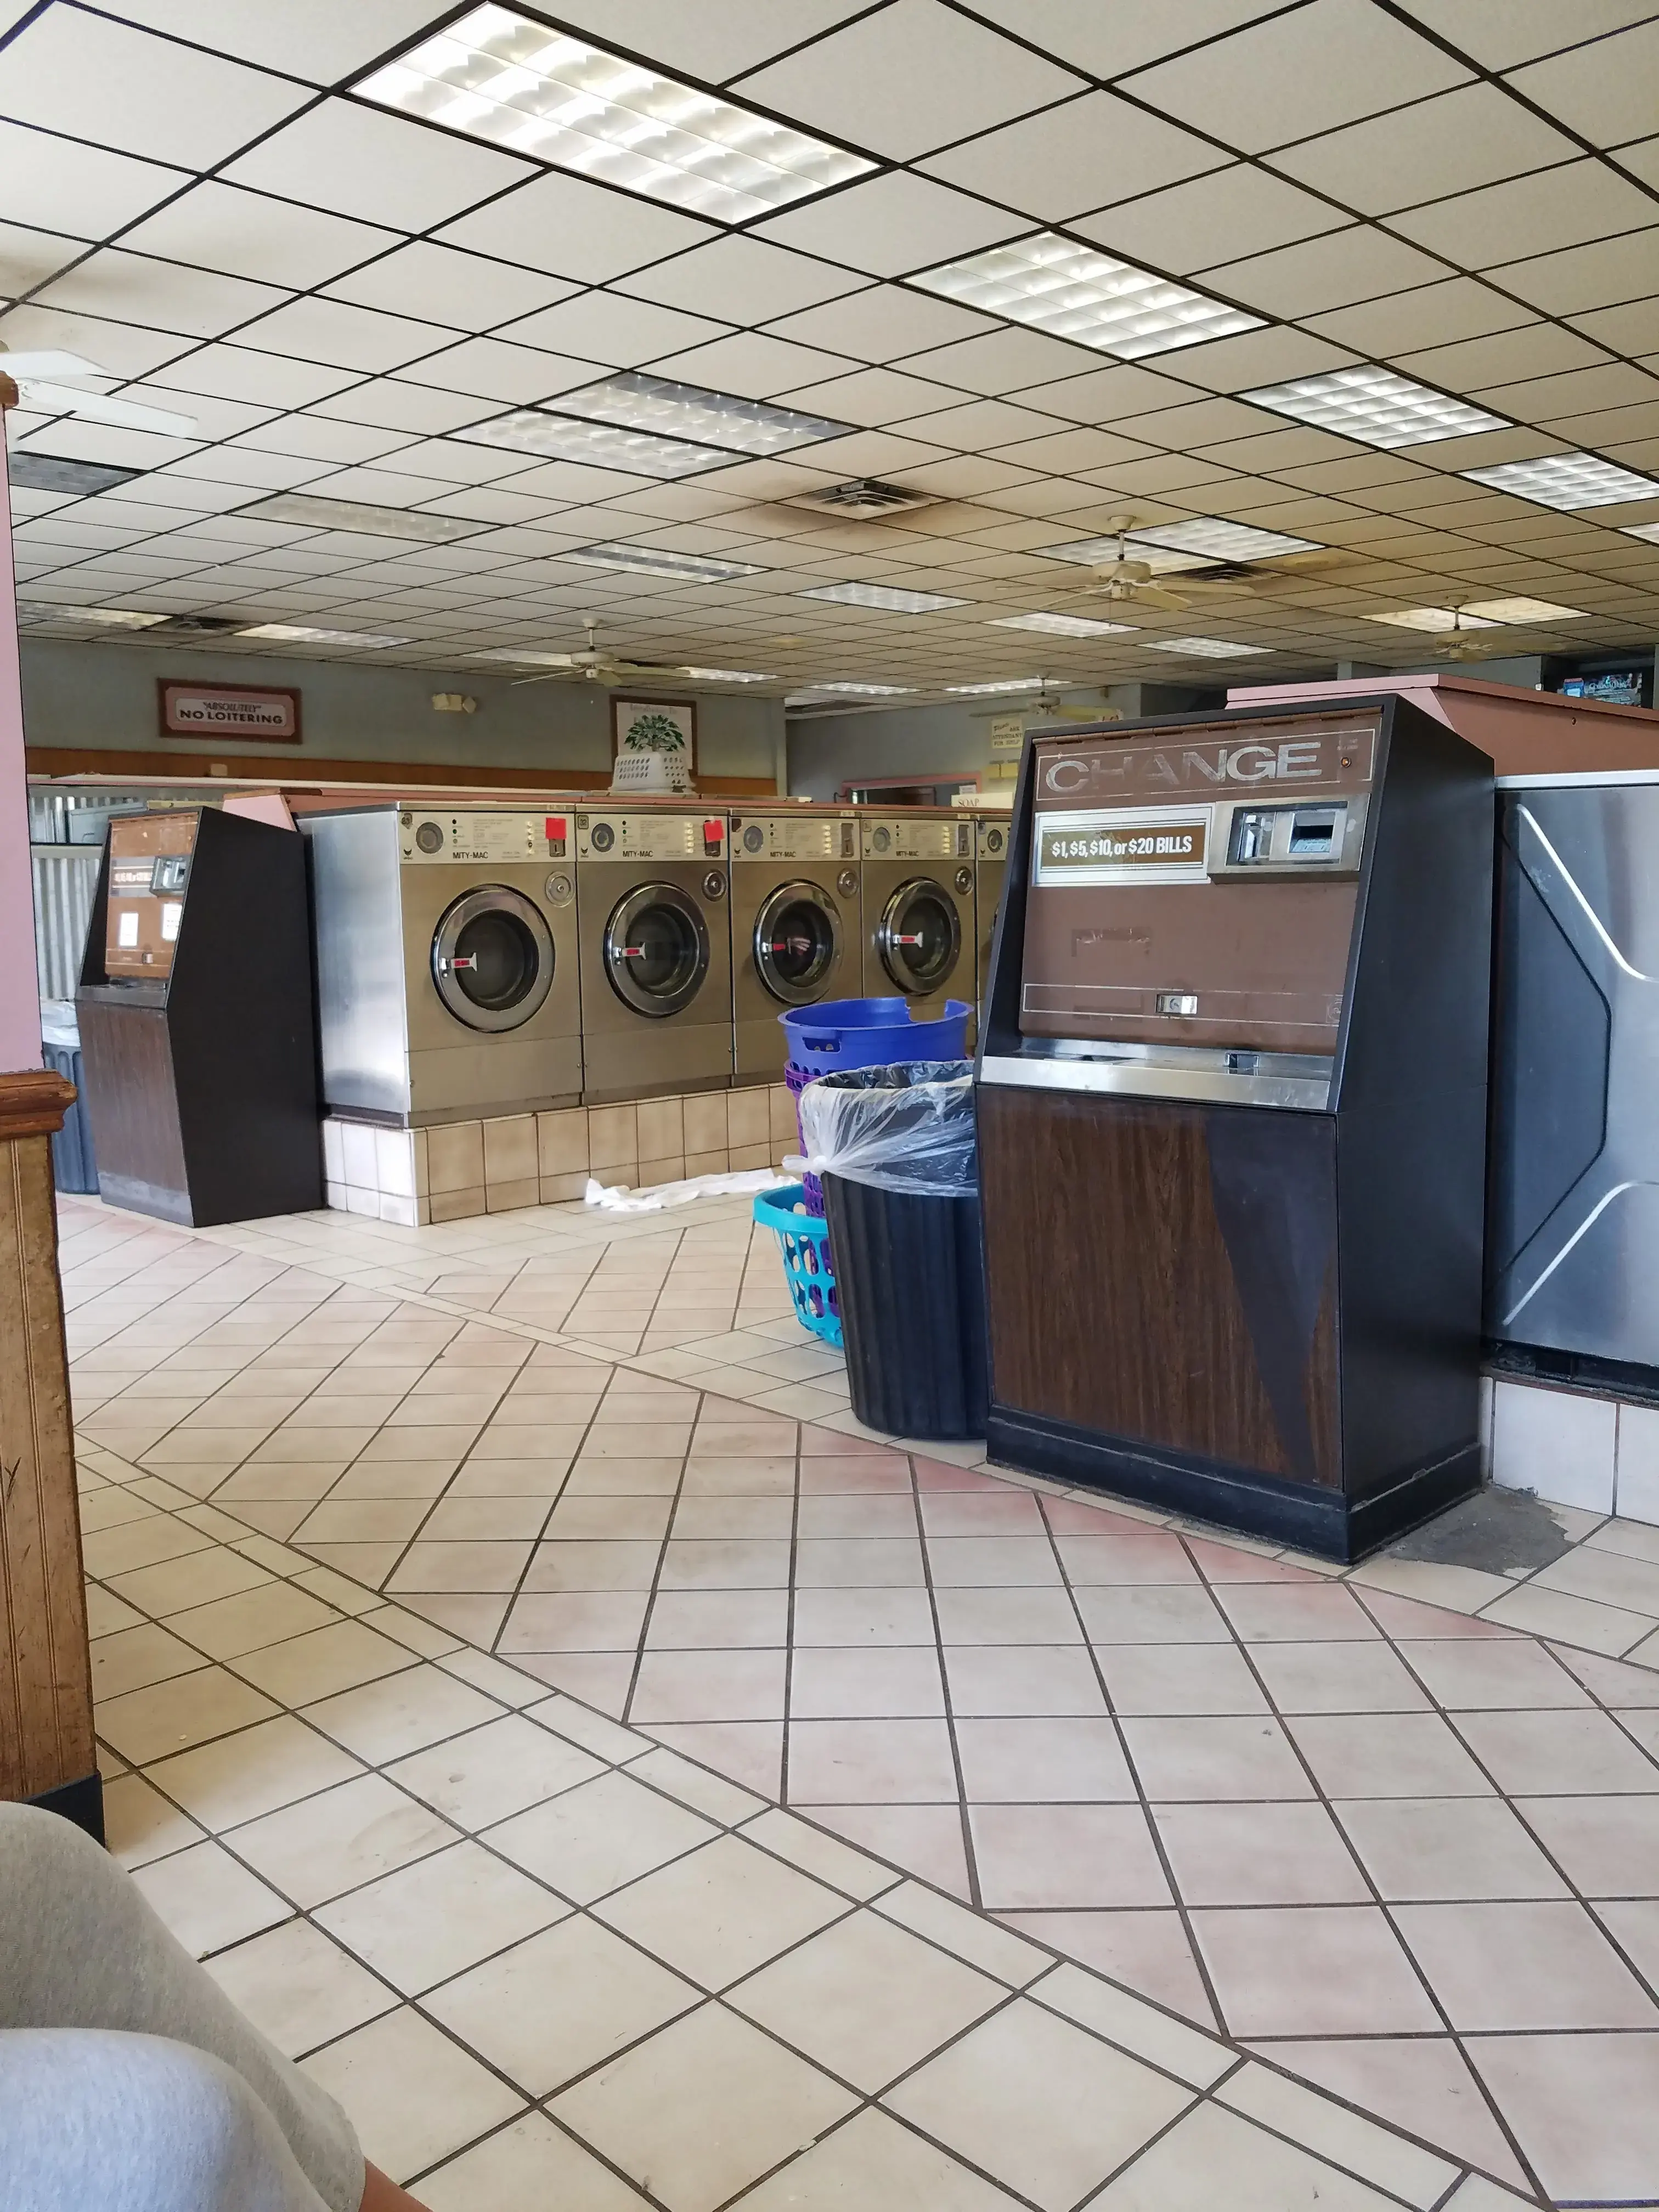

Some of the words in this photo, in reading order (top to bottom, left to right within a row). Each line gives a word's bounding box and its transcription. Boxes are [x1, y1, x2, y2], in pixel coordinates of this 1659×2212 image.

[180, 709, 204, 719] NO
[207, 712, 283, 724] LOITERING
[1045, 741, 1322, 793] CHANGE
[958, 798, 980, 807] SOAP
[1128, 837, 1154, 855] $20
[1156, 836, 1192, 854] BILLS
